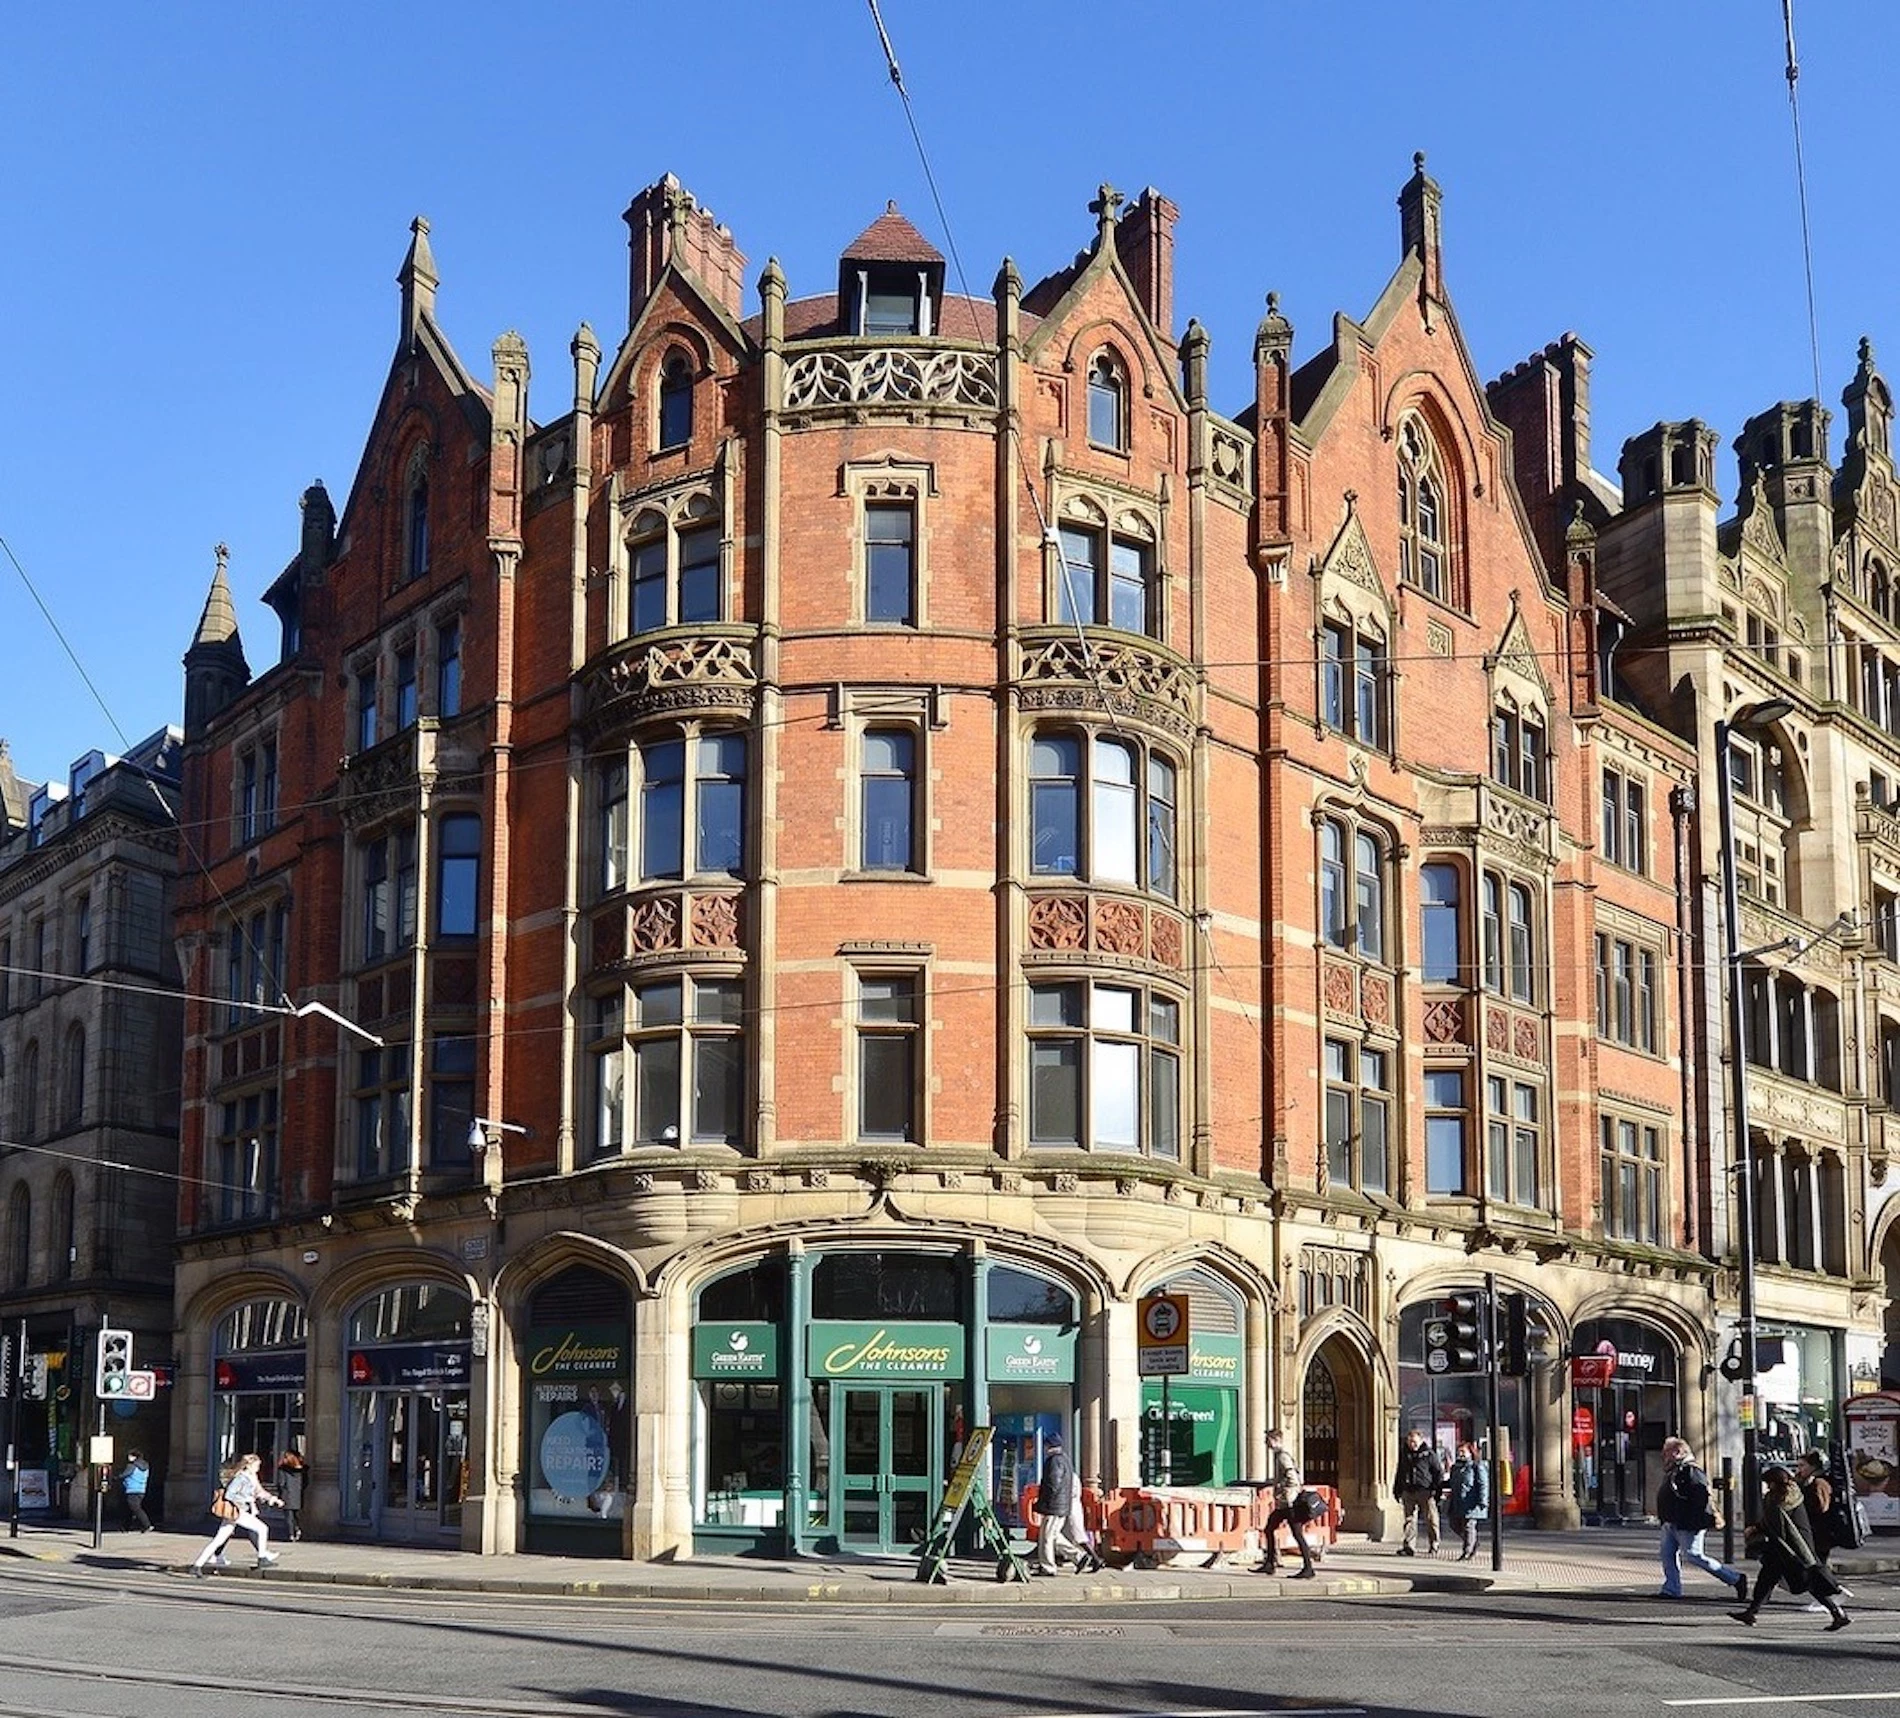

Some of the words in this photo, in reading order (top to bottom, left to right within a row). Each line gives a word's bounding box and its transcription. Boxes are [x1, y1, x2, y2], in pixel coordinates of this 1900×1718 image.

[532, 1332, 619, 1374] Johnsons
[825, 1330, 950, 1372] Johnsons
[555, 1361, 570, 1370] THE
[572, 1360, 616, 1370] CLEANERS
[886, 1362, 945, 1370] CLEANERS
[1618, 1352, 1654, 1372] money
[1194, 1369, 1234, 1378] CLEANERS
[539, 1391, 579, 1402] REPAIRS
[1180, 1408, 1215, 1422] Green!
[546, 1456, 604, 1470] REPAIR?
